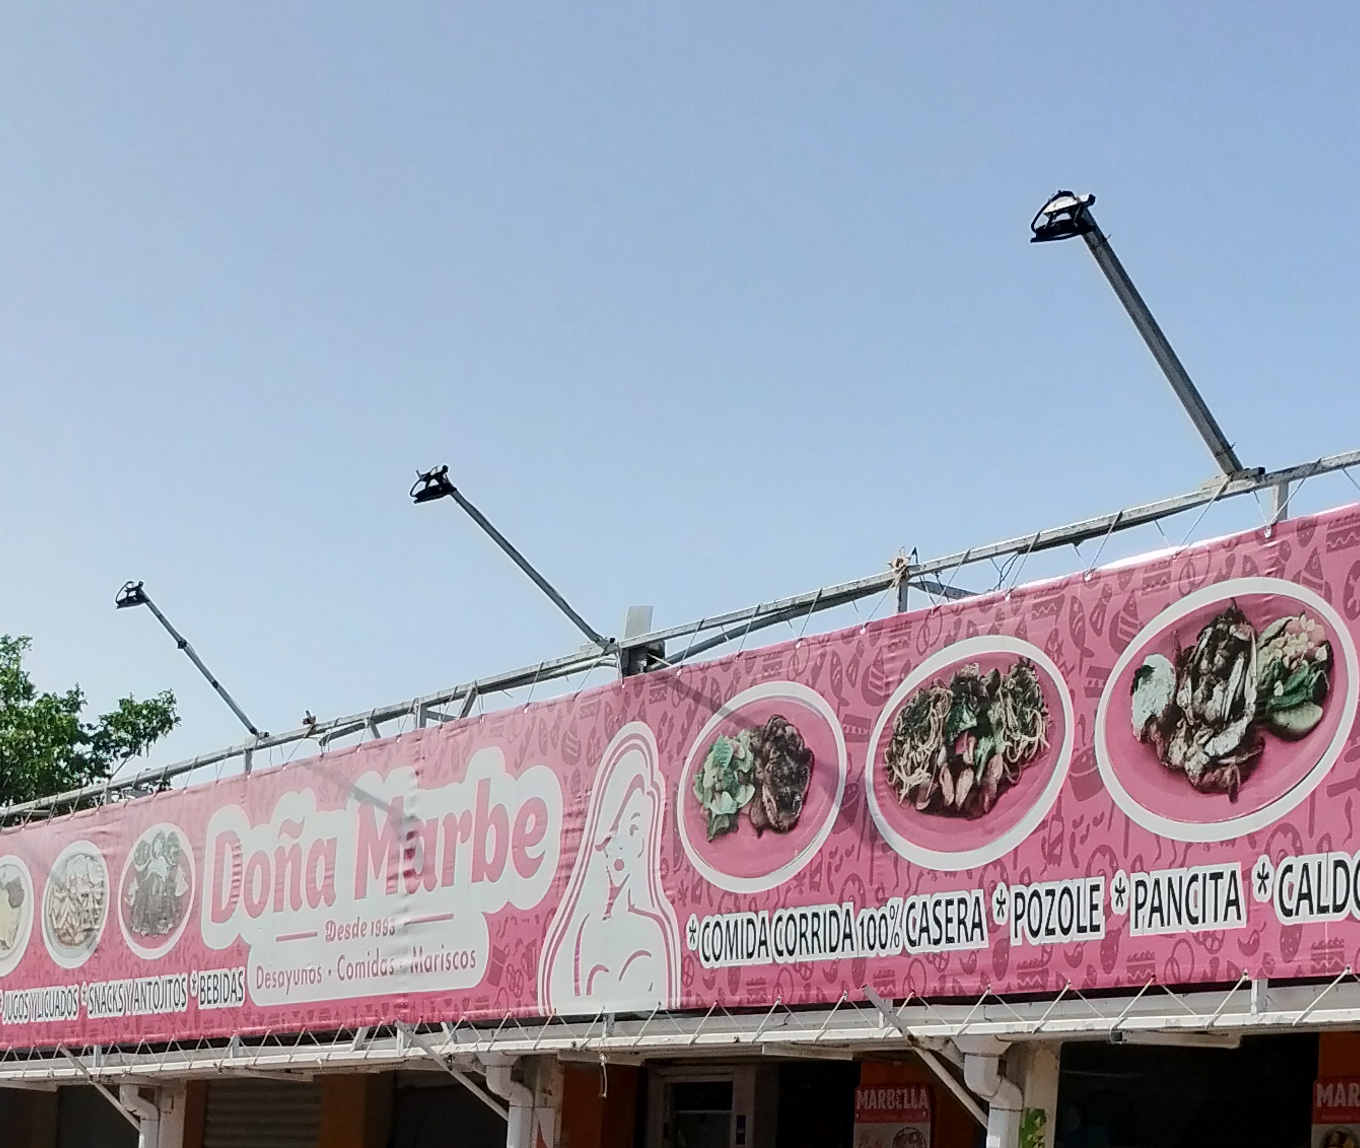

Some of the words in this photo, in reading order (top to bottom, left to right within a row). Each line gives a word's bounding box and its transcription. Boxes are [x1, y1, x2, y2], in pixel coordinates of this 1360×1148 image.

[211, 816, 338, 924] Doña
[354, 776, 549, 901] Marbe
[325, 917, 367, 942] Desde
[701, 916, 771, 962] COMIDA
[773, 908, 854, 957] CORRIDA
[858, 903, 902, 950] 100%
[905, 896, 985, 946] CASERA
[1015, 884, 1100, 939] POZOLE
[1135, 870, 1242, 929] PANCITA
[256, 965, 322, 995] Desayunos
[337, 948, 395, 981] Comidas
[409, 944, 477, 974] Mariscos
[3, 991, 29, 1021] JUGOS
[89, 984, 124, 1015] SNACKS
[134, 977, 186, 1011] ANTOJITOS
[200, 971, 244, 1006] BEBIDAS
[856, 1087, 928, 1110] MARBELLA
